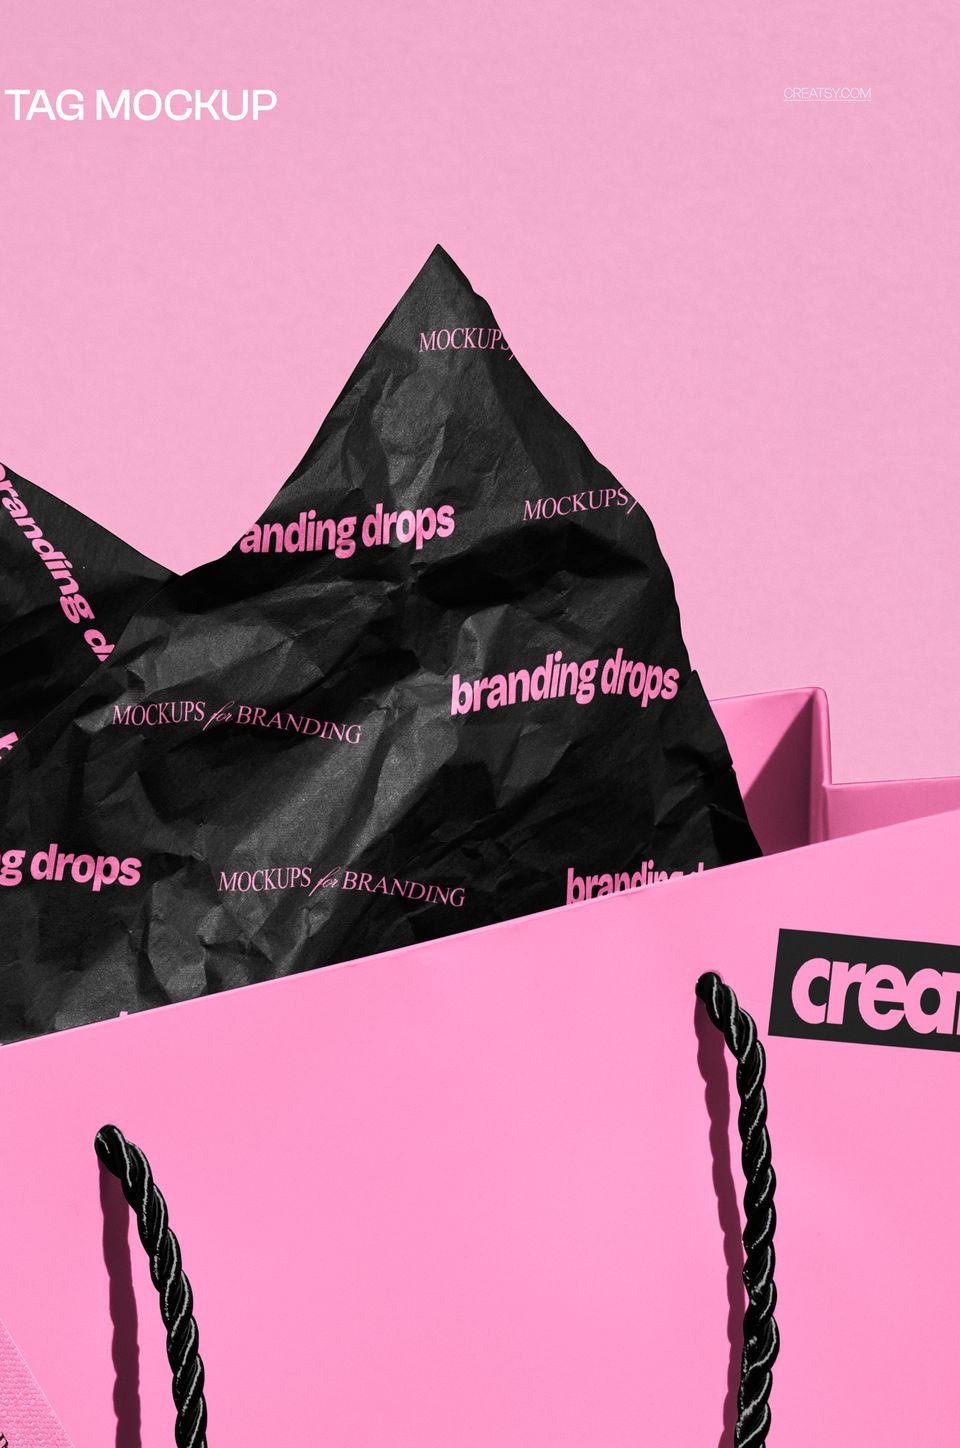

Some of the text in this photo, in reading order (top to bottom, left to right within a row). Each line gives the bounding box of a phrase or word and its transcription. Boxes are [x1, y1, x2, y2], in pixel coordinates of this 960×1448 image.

[362, 502, 455, 550] drops
[523, 487, 630, 521] MOCKUPS
[450, 648, 680, 715] branding drops
[112, 700, 361, 744] MOCKUPS for BRANDING
[30, 844, 141, 892] drops
[217, 866, 465, 907] MOCKUPS for BRANDING
[791, 957, 960, 1036] crea
